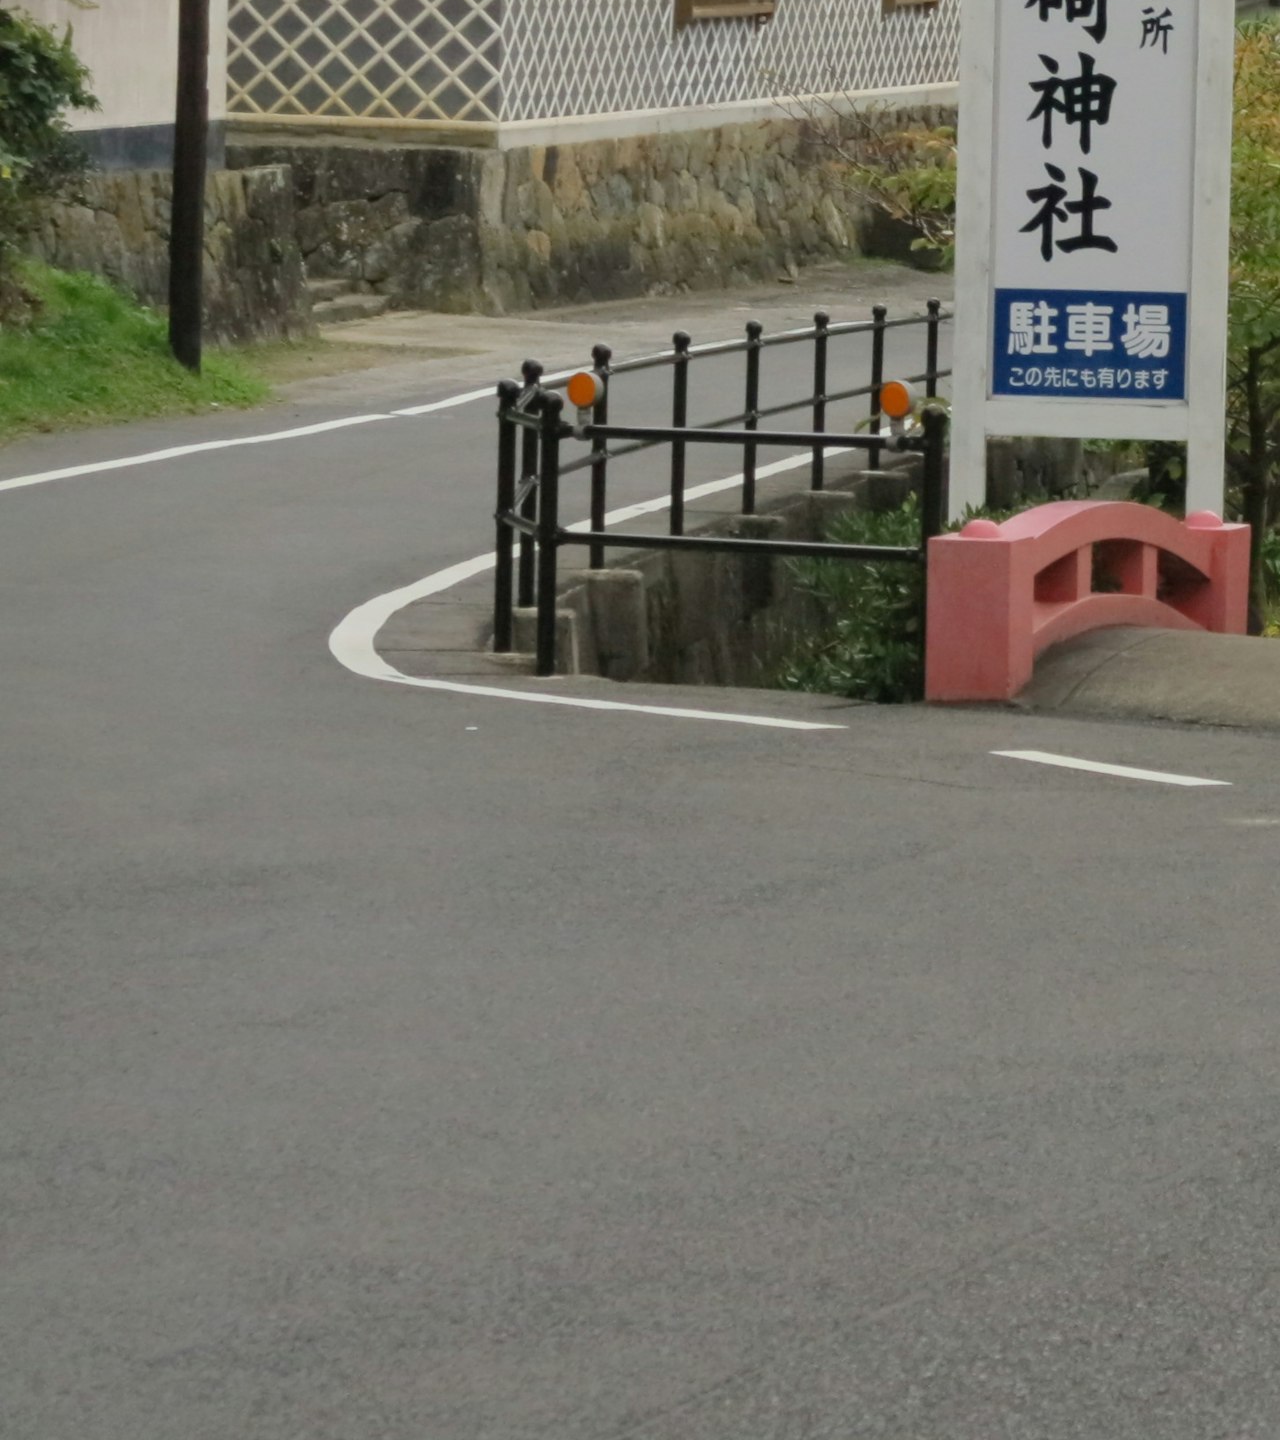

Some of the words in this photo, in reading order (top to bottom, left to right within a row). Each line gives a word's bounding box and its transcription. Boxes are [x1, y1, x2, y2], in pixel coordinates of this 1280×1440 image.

[1007, 300, 1172, 359] 駐車場
[1008, 367, 1169, 390] この先にも有ります
